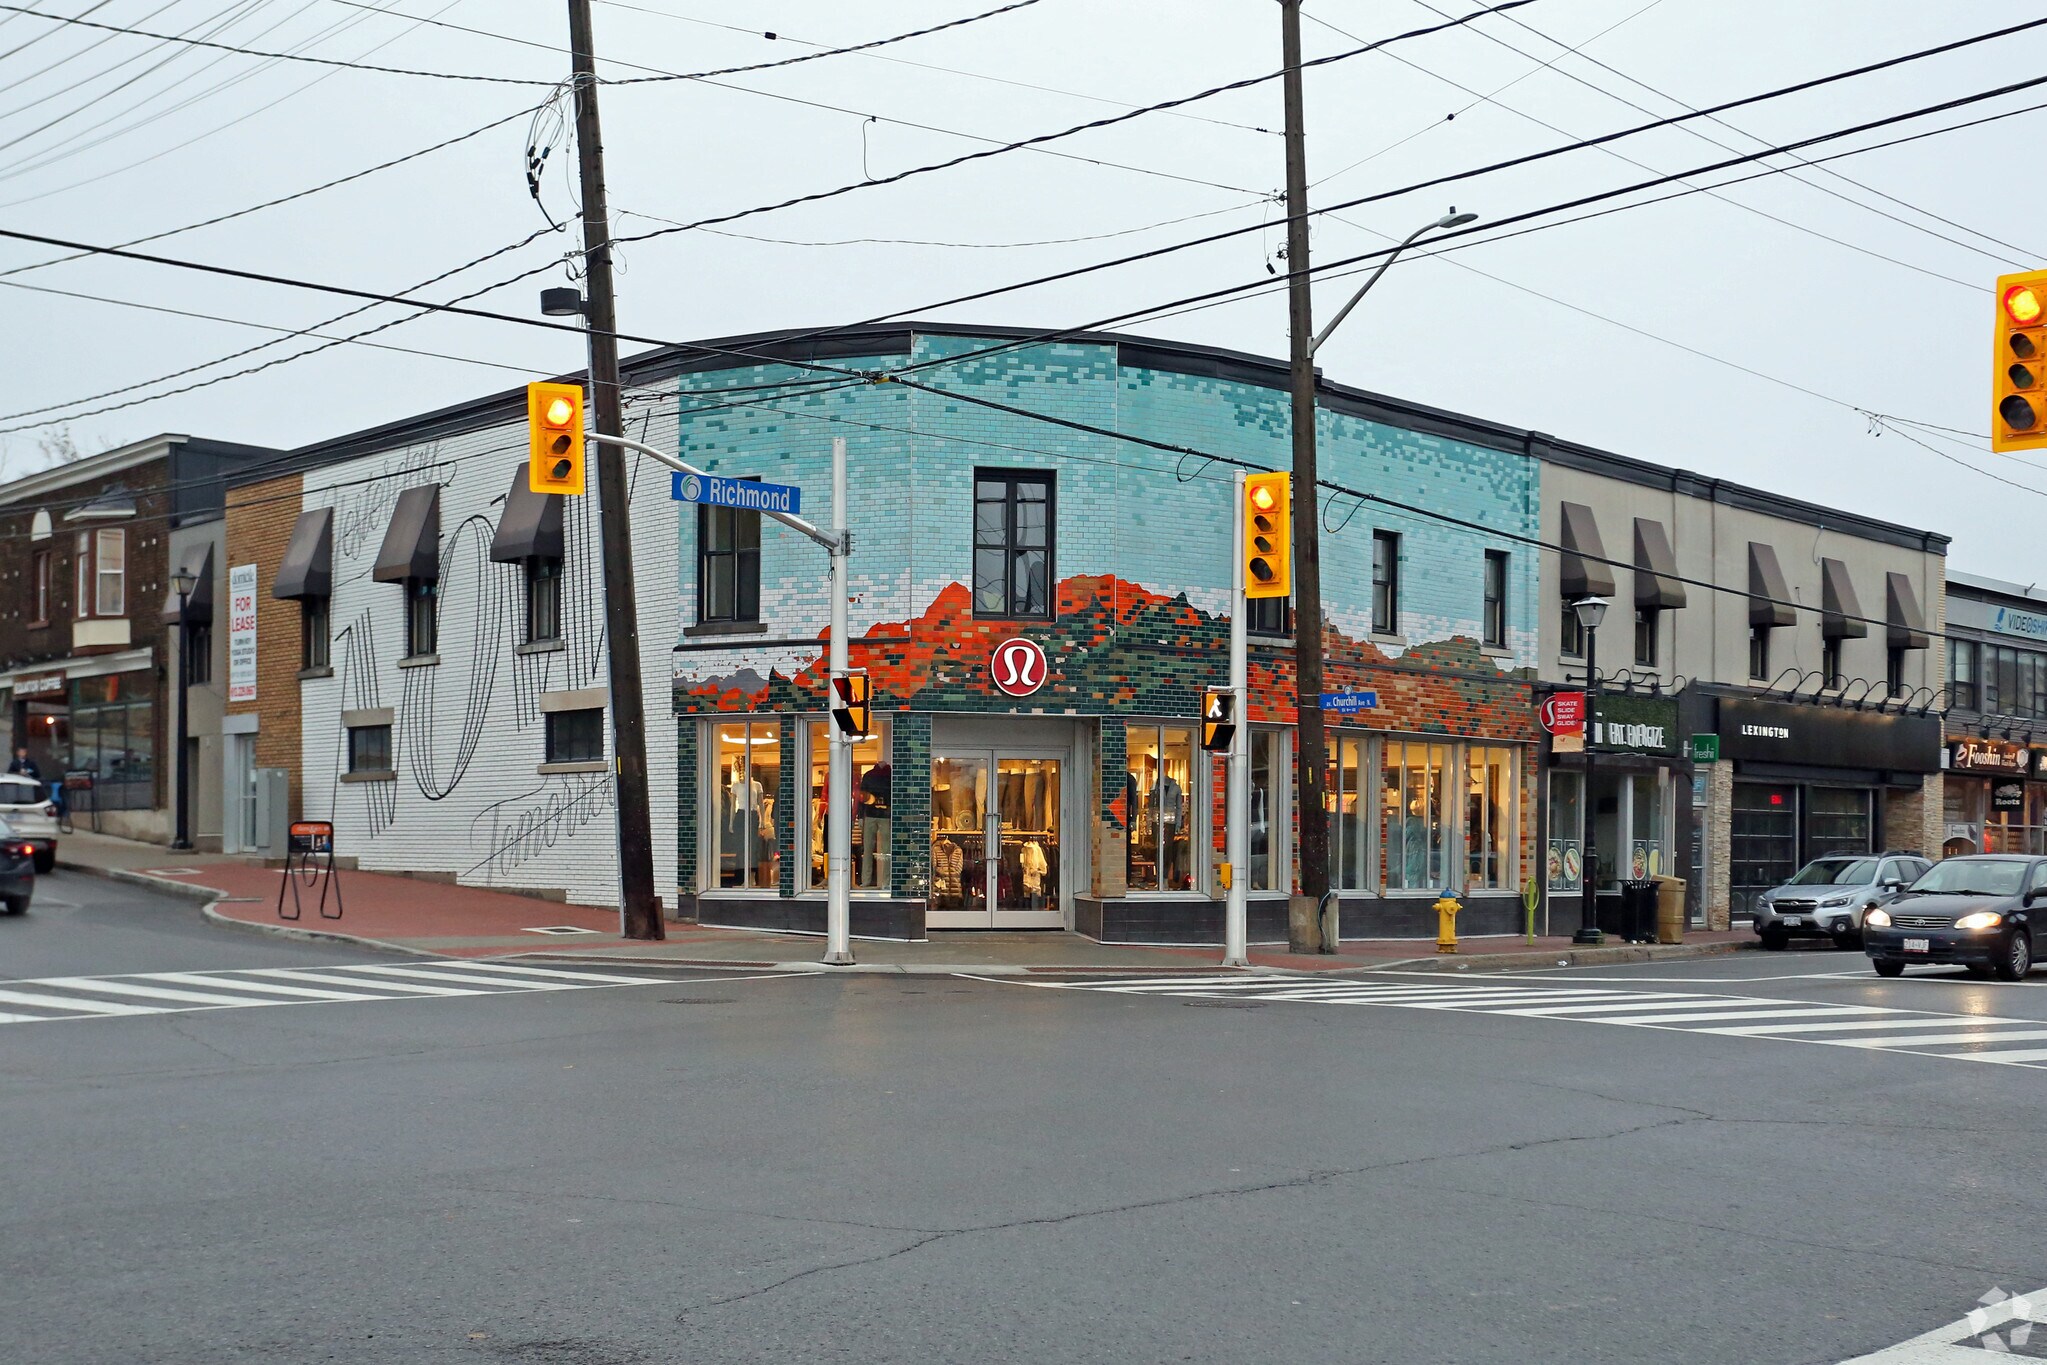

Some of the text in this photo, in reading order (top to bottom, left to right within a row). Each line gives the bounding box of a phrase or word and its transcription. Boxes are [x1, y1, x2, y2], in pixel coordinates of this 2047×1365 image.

[710, 478, 790, 511] Richmond
[235, 596, 252, 612] FOR
[231, 615, 255, 632] LEASE
[1332, 696, 1357, 707] Churchill
[1609, 722, 1627, 745] EAT.
[1626, 723, 1667, 748] ENERGIZE.
[1742, 724, 1789, 739] LEXINGTON
[1694, 743, 1714, 759] freshii
[1966, 743, 2001, 768] Fooshin
